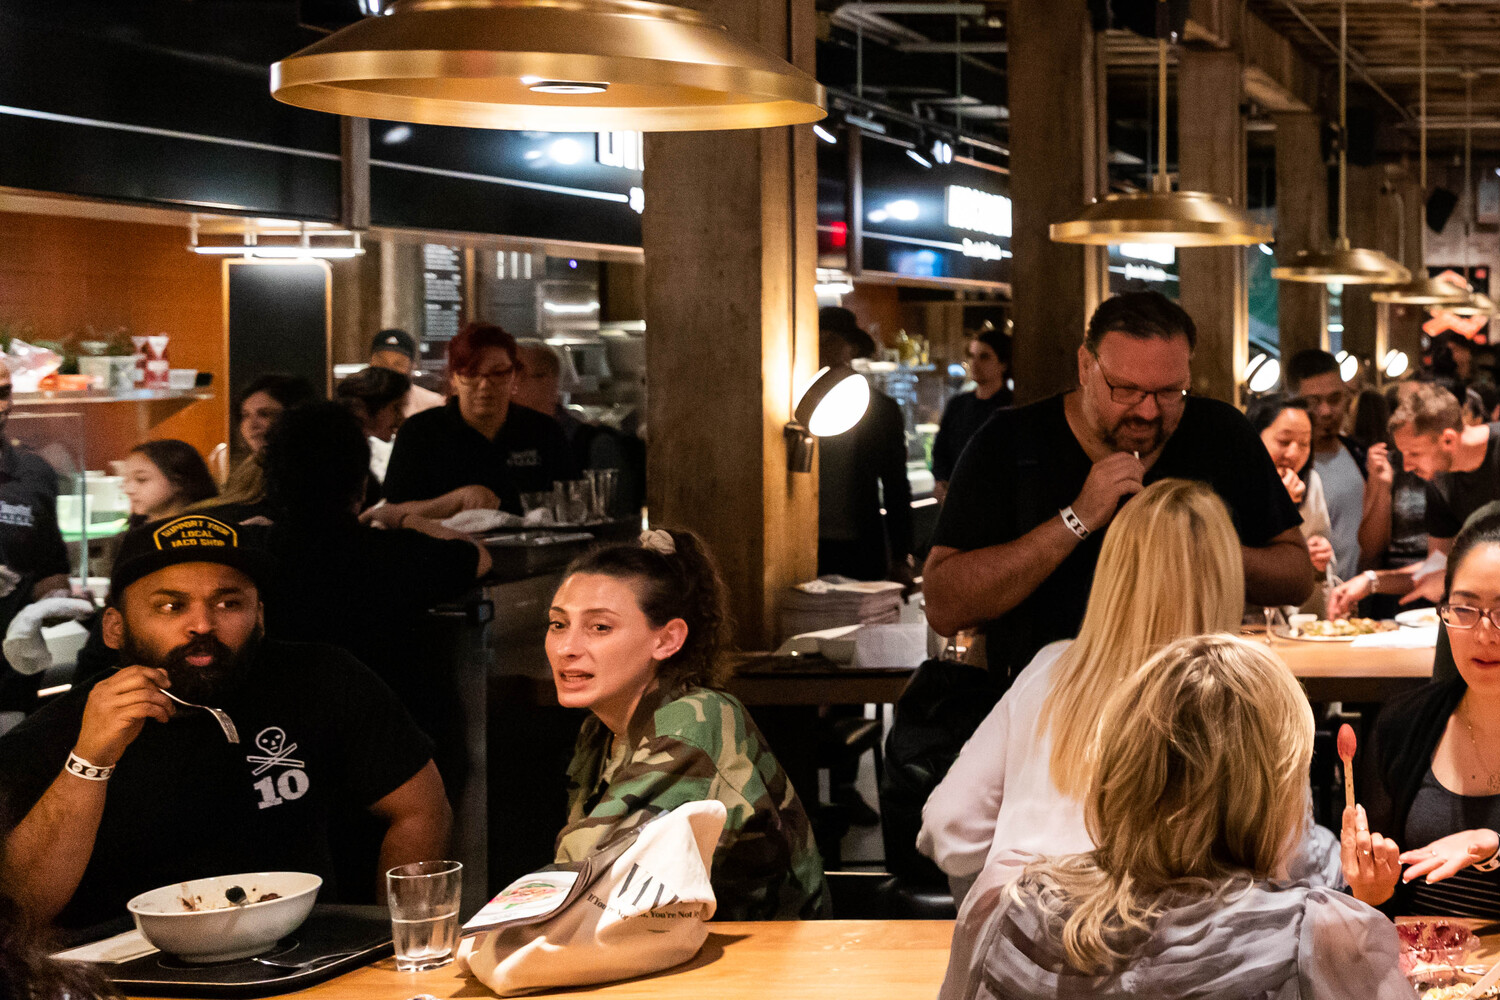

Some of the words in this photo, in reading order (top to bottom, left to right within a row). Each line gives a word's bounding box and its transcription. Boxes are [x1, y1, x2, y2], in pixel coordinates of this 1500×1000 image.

[160, 520, 204, 537] SUPPORT
[181, 530, 214, 538] LOCAL
[170, 538, 198, 547] TACO
[200, 538, 226, 547] SHOP
[253, 769, 309, 809] 10
